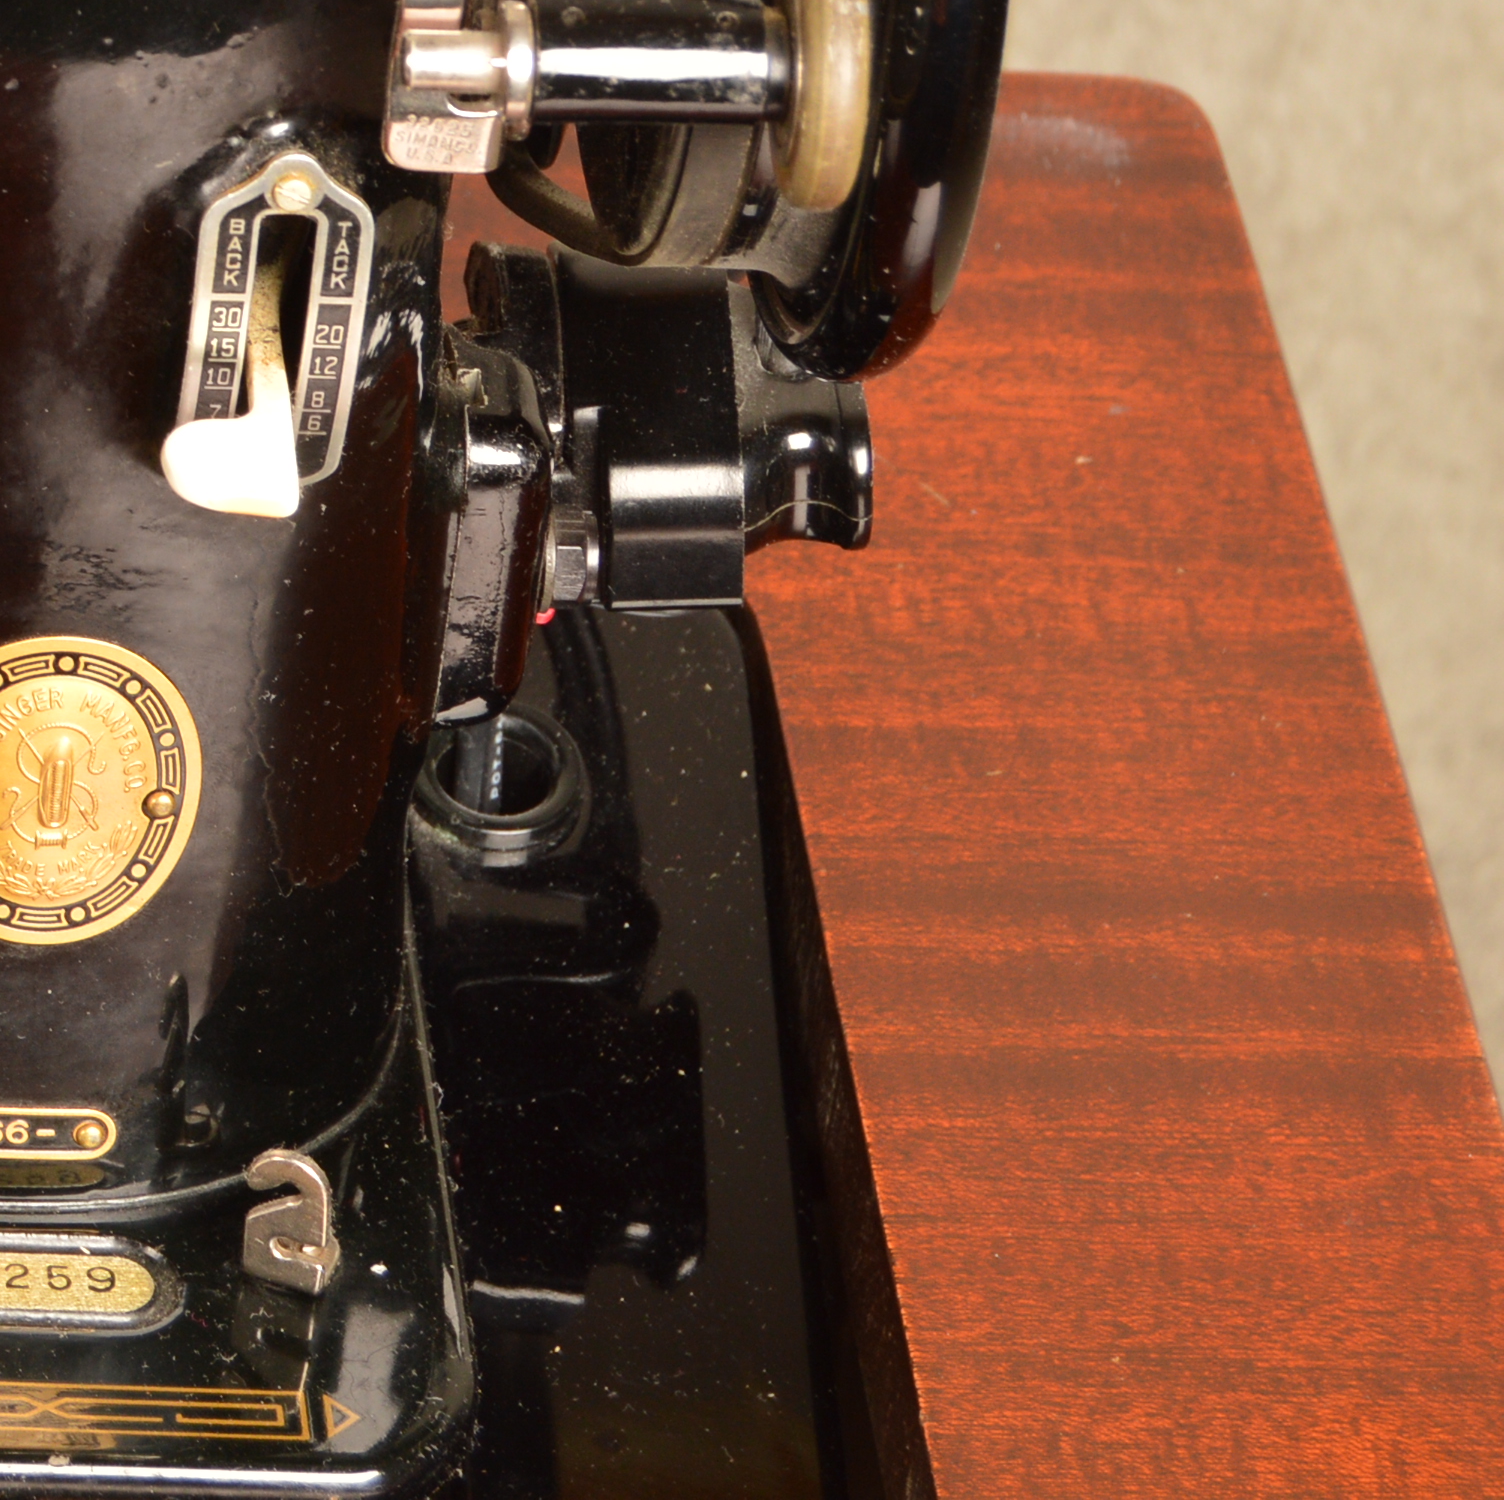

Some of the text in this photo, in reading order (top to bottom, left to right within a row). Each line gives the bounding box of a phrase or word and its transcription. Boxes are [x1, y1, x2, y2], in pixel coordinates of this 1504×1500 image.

[222, 217, 247, 288] BACK
[329, 220, 353, 291] TACK
[212, 306, 241, 328] 30
[314, 323, 345, 345] 20
[209, 336, 236, 359] 15
[312, 355, 337, 376] 12
[205, 366, 231, 387] 10
[310, 390, 326, 409] 8
[209, 403, 222, 419] 7
[306, 414, 322, 432] 6
